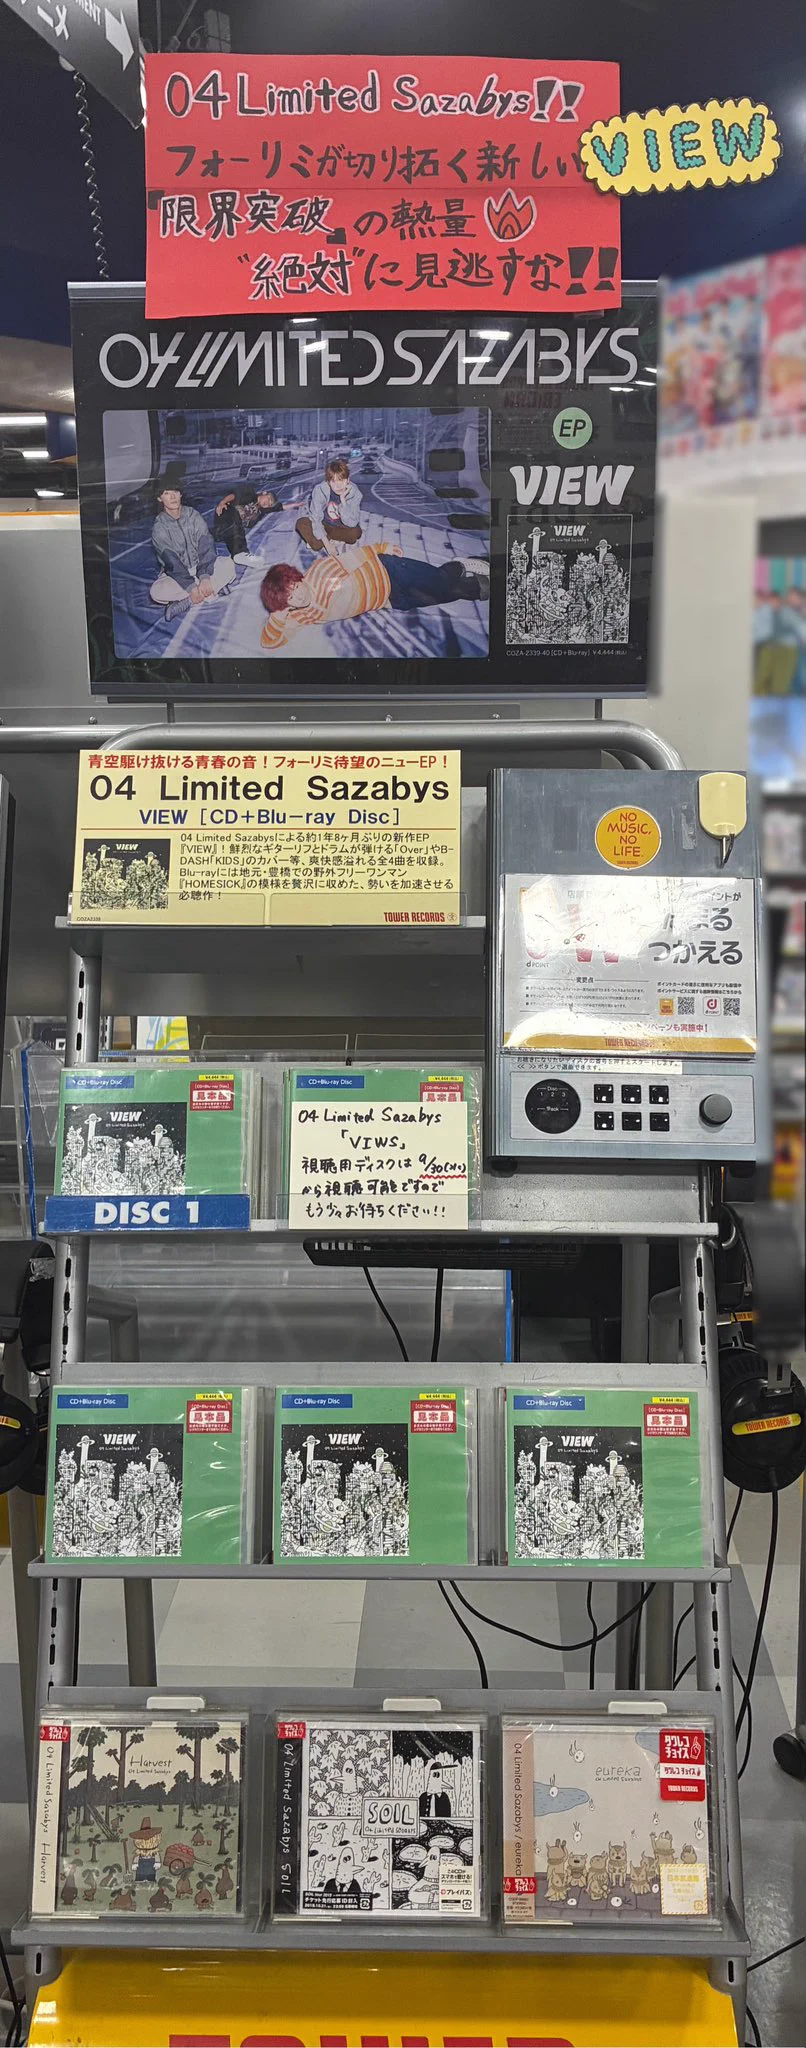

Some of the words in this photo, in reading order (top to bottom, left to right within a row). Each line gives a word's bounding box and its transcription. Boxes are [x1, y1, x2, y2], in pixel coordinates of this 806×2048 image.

[166, 71, 229, 119] 04
[237, 71, 380, 116] Limited
[591, 113, 765, 177] VIEW
[166, 140, 583, 184] フォーリミが切り拓く新しい
[175, 330, 385, 388] LIMITED
[386, 328, 639, 385] SAZABYS
[559, 419, 586, 437] EP
[509, 465, 635, 506] VIEW
[553, 525, 586, 536] VIEW
[90, 775, 136, 800] 04
[160, 775, 284, 801] Limited
[307, 775, 449, 803] Sazabys
[139, 810, 188, 824] VIEW
[620, 812, 637, 822] NO
[607, 823, 652, 835] MUSIC,
[196, 833, 231, 842] Limited
[620, 835, 637, 845] NO
[384, 912, 409, 922] TOWER
[411, 912, 445, 922] RECORDS
[648, 940, 743, 964] つかえる
[109, 1111, 142, 1122] VIEW
[298, 1109, 319, 1123] 04
[323, 1107, 374, 1124] Limited
[381, 1107, 442, 1126] Sazabys
[301, 1156, 412, 1174] 視聴用ディスクは
[301, 1179, 445, 1198] から視聴可能ですので
[95, 1201, 170, 1224] DISC
[186, 1201, 199, 1223] 1
[69, 1398, 102, 1406] CD+Blu-ray
[294, 1398, 327, 1406] CD+Blu-ray
[526, 1399, 558, 1407] CD+Blu-ray
[559, 1399, 572, 1407] Disc
[745, 1420, 766, 1431] TOWER
[103, 1434, 136, 1445] VIEW
[328, 1433, 362, 1444] VIEW
[561, 1436, 594, 1447] VIEW
[665, 1735, 690, 1747] タワレコ
[514, 1743, 522, 1755] 04
[665, 1747, 690, 1759] チョイス
[130, 1755, 172, 1767] Harvest
[514, 1756, 523, 1791] Limited
[596, 1766, 641, 1776] eureka
[681, 1767, 696, 1775] チョイス
[283, 1762, 293, 1801] Limited
[368, 1802, 415, 1825] SOIL
[513, 1793, 523, 1833] Sazabys
[280, 1805, 292, 1854] Sazabys
